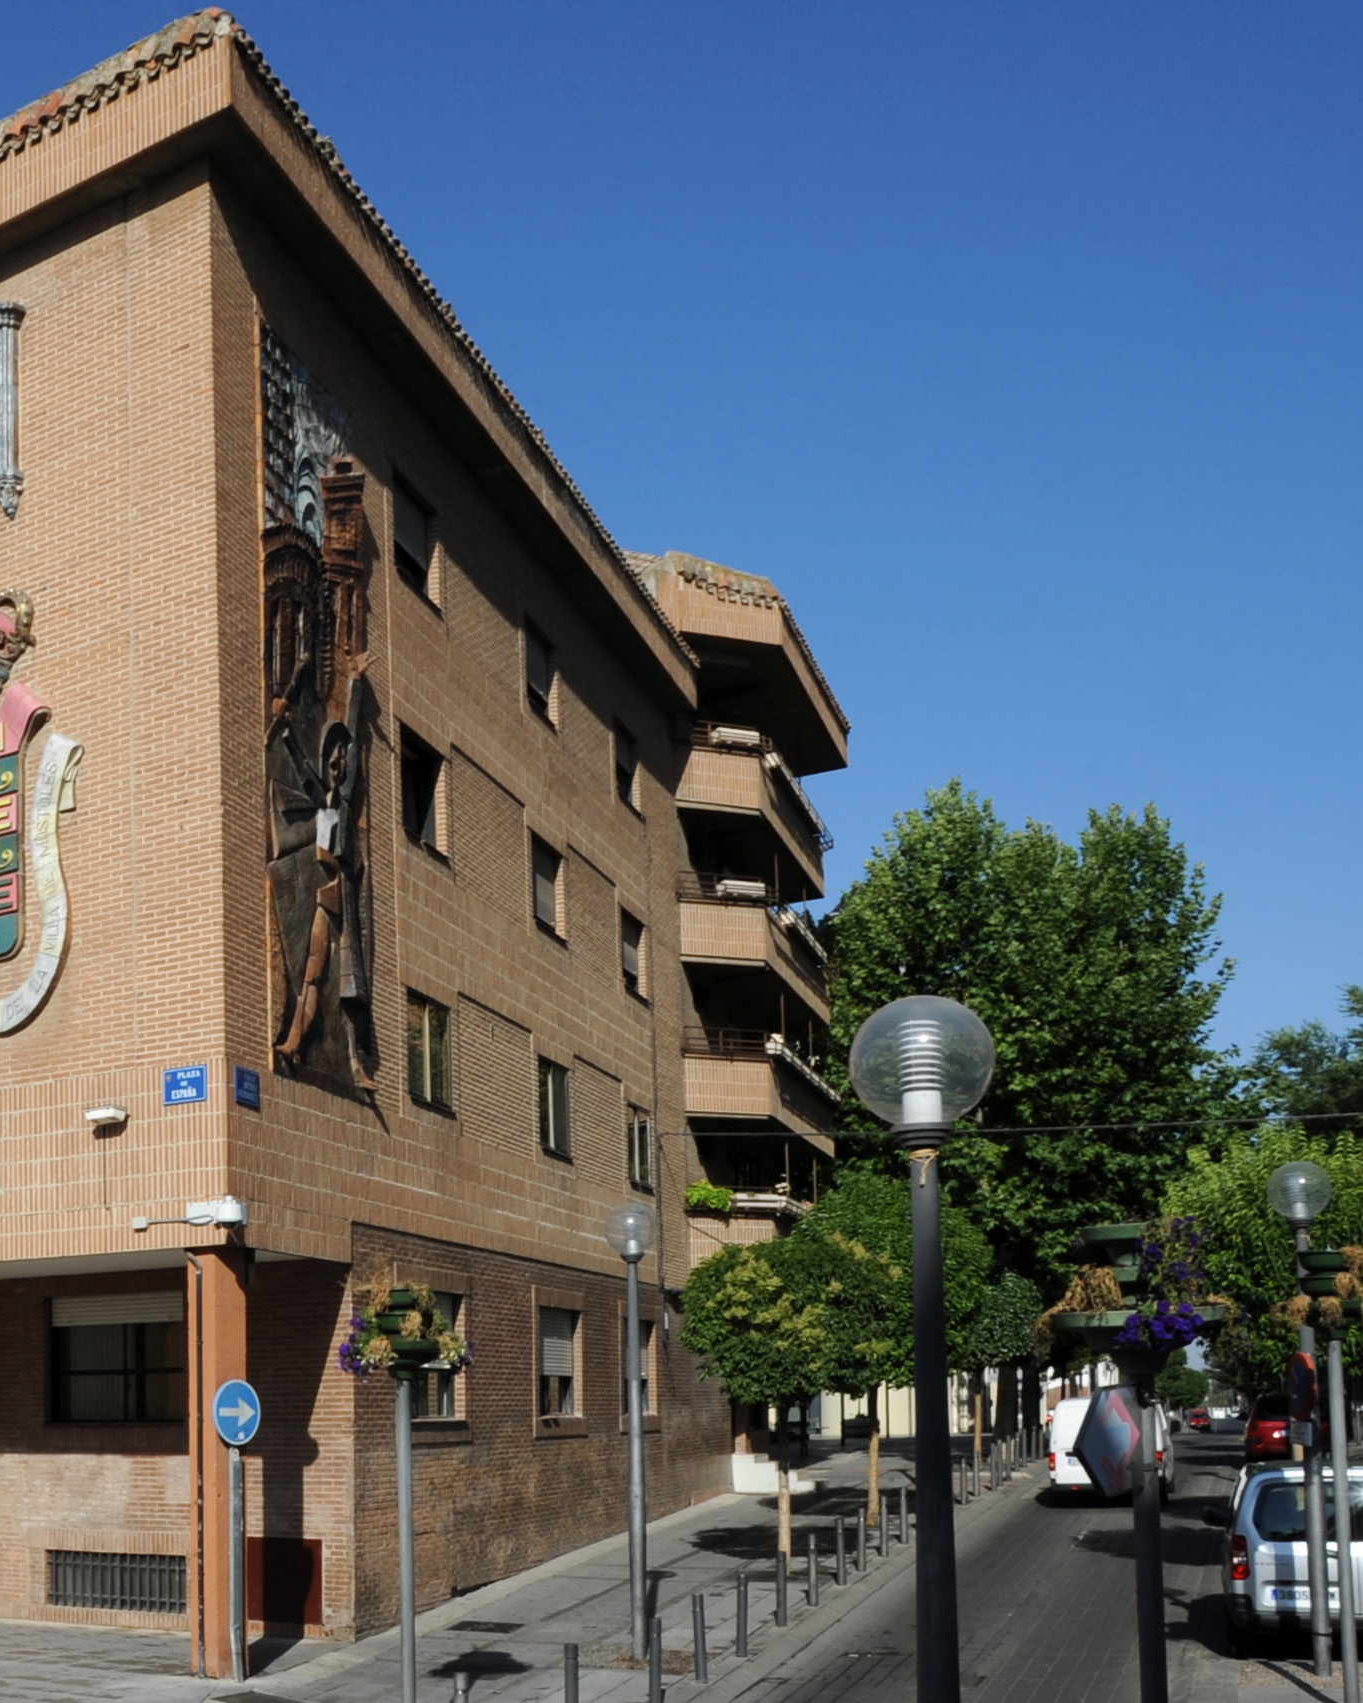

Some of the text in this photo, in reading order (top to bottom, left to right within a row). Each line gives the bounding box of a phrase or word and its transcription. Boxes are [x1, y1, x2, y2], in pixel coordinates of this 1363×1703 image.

[44, 904, 60, 951] VILLA
[177, 1069, 201, 1079] PLAZA
[171, 1087, 197, 1100] ESPAÑA
